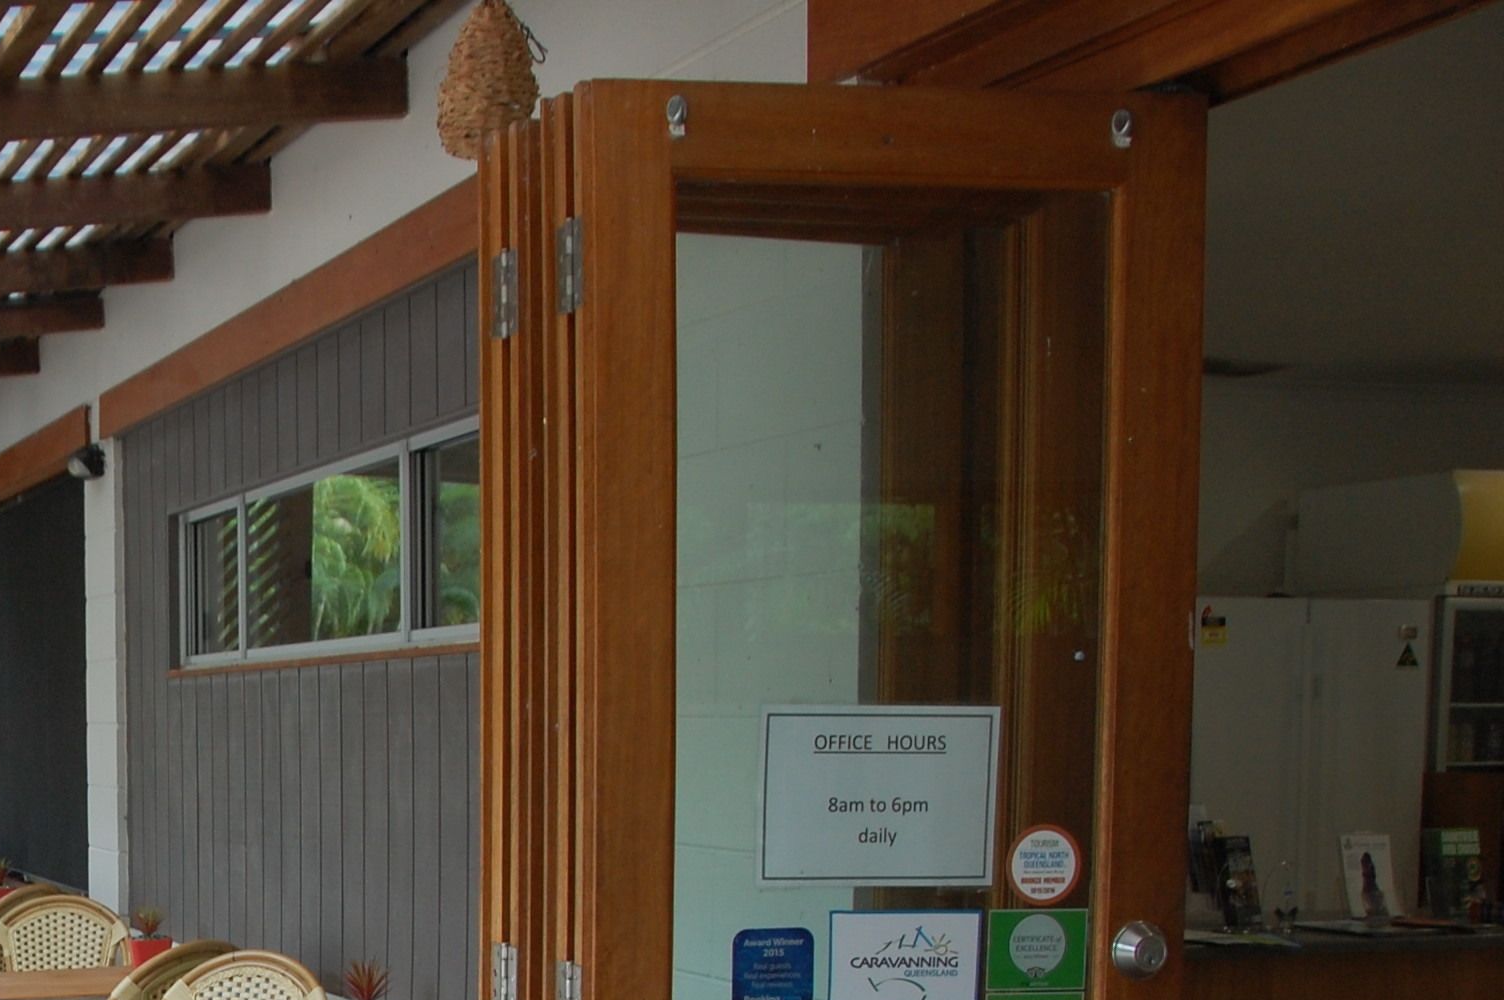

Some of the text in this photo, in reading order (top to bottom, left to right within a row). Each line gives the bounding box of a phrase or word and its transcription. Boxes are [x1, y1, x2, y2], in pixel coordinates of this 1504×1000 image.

[814, 734, 947, 751] OFFICE HOURS
[828, 797, 929, 815] 8am to 6pm
[858, 827, 897, 847] daily
[1049, 851, 1070, 859] NORTH
[1023, 860, 1065, 869] QUEENSLAND
[743, 937, 805, 947] Award Winner
[763, 948, 785, 957] 2015
[1015, 944, 1057, 953] EXCELLENCE
[850, 956, 959, 969] CARAVANNING
[904, 969, 959, 977] QUEENSLAND
